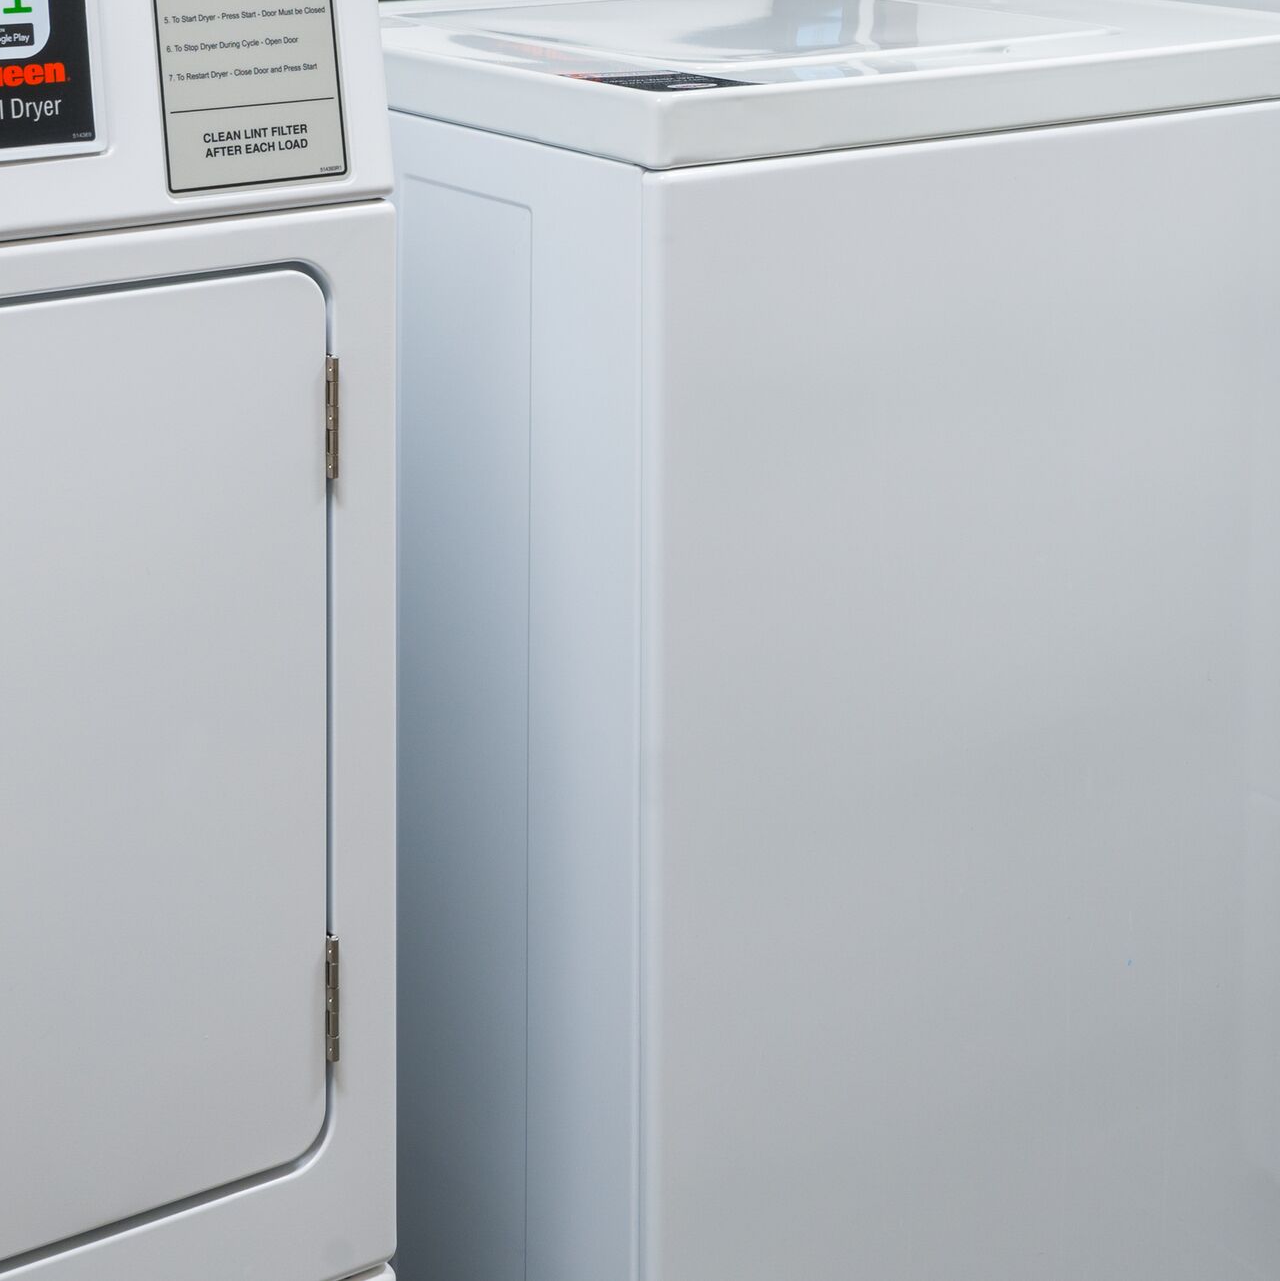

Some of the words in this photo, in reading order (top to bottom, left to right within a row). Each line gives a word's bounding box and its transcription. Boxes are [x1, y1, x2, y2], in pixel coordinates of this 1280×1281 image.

[182, 15, 197, 23] Start
[198, 14, 216, 24] Dryer
[222, 13, 240, 21] Press
[241, 11, 257, 19] Start
[262, 10, 277, 18] Door
[278, 8, 293, 16] Must
[294, 7, 303, 15] be
[304, 6, 325, 14] Closed
[13, 33, 30, 43] Play
[184, 44, 199, 53] Stop
[200, 43, 218, 52] Dryer
[219, 41, 240, 50] During
[241, 39, 259, 49] Cycle
[265, 38, 282, 47] Open
[283, 36, 299, 44] Door
[186, 72, 210, 81] Restart
[211, 71, 228, 80] Dryer
[234, 69, 252, 77] Close
[254, 67, 269, 76] Door
[270, 66, 282, 74] and
[283, 64, 302, 73] Press
[302, 63, 318, 71] Start
[11, 98, 62, 122] Dryer
[203, 130, 242, 144] CLEAN
[244, 127, 268, 140] LINT
[271, 123, 308, 137] FILTER
[205, 144, 242, 159] AFTER
[245, 142, 276, 155] EACH
[278, 138, 308, 151] LOAD
